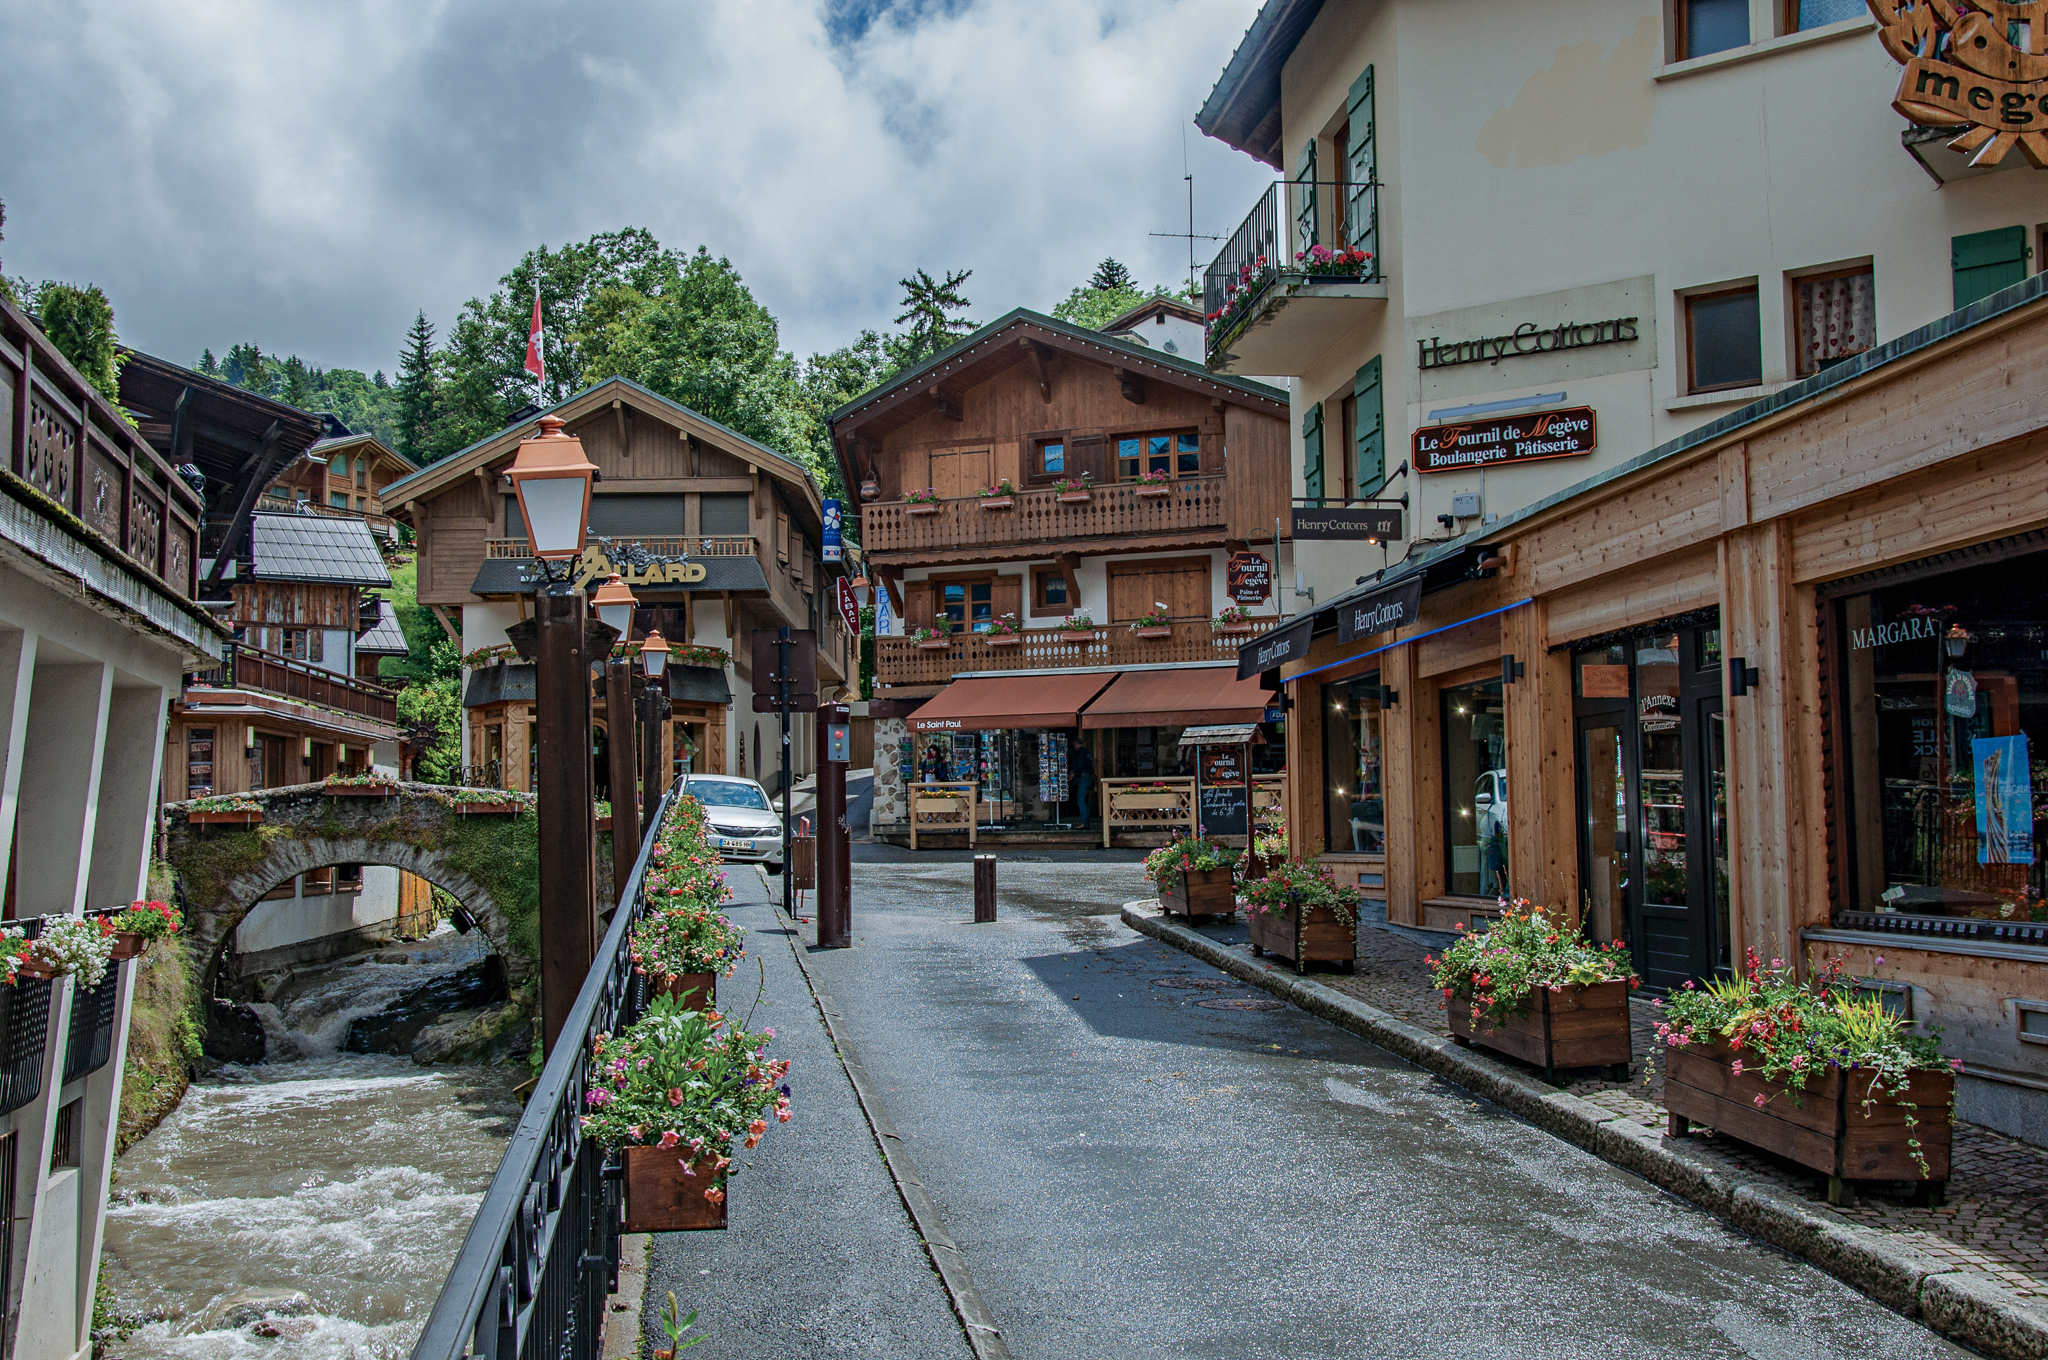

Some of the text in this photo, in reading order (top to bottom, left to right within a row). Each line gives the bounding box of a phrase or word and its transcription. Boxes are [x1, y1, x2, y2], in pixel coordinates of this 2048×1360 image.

[1417, 336, 1508, 366] Henry
[1419, 414, 1589, 451] Le Fournil de Megève
[1429, 437, 1579, 466] Boulangerie Pâtisserie
[1297, 519, 1328, 532] Henry
[1230, 560, 1268, 572] Fournil
[1229, 573, 1268, 587] Megève
[842, 590, 857, 623] TABAC
[878, 588, 890, 634] BAR
[1354, 610, 1375, 633] Henry
[1852, 616, 1936, 650] MARGARA
[1257, 647, 1271, 665] Henry
[1641, 694, 1676, 713] l'Annexe
[917, 721, 925, 729] Le
[945, 720, 962, 728] Paul
[1643, 719, 1676, 732] Cordonnerie
[1205, 755, 1235, 767] Fournil
[1210, 767, 1240, 779] Megève
